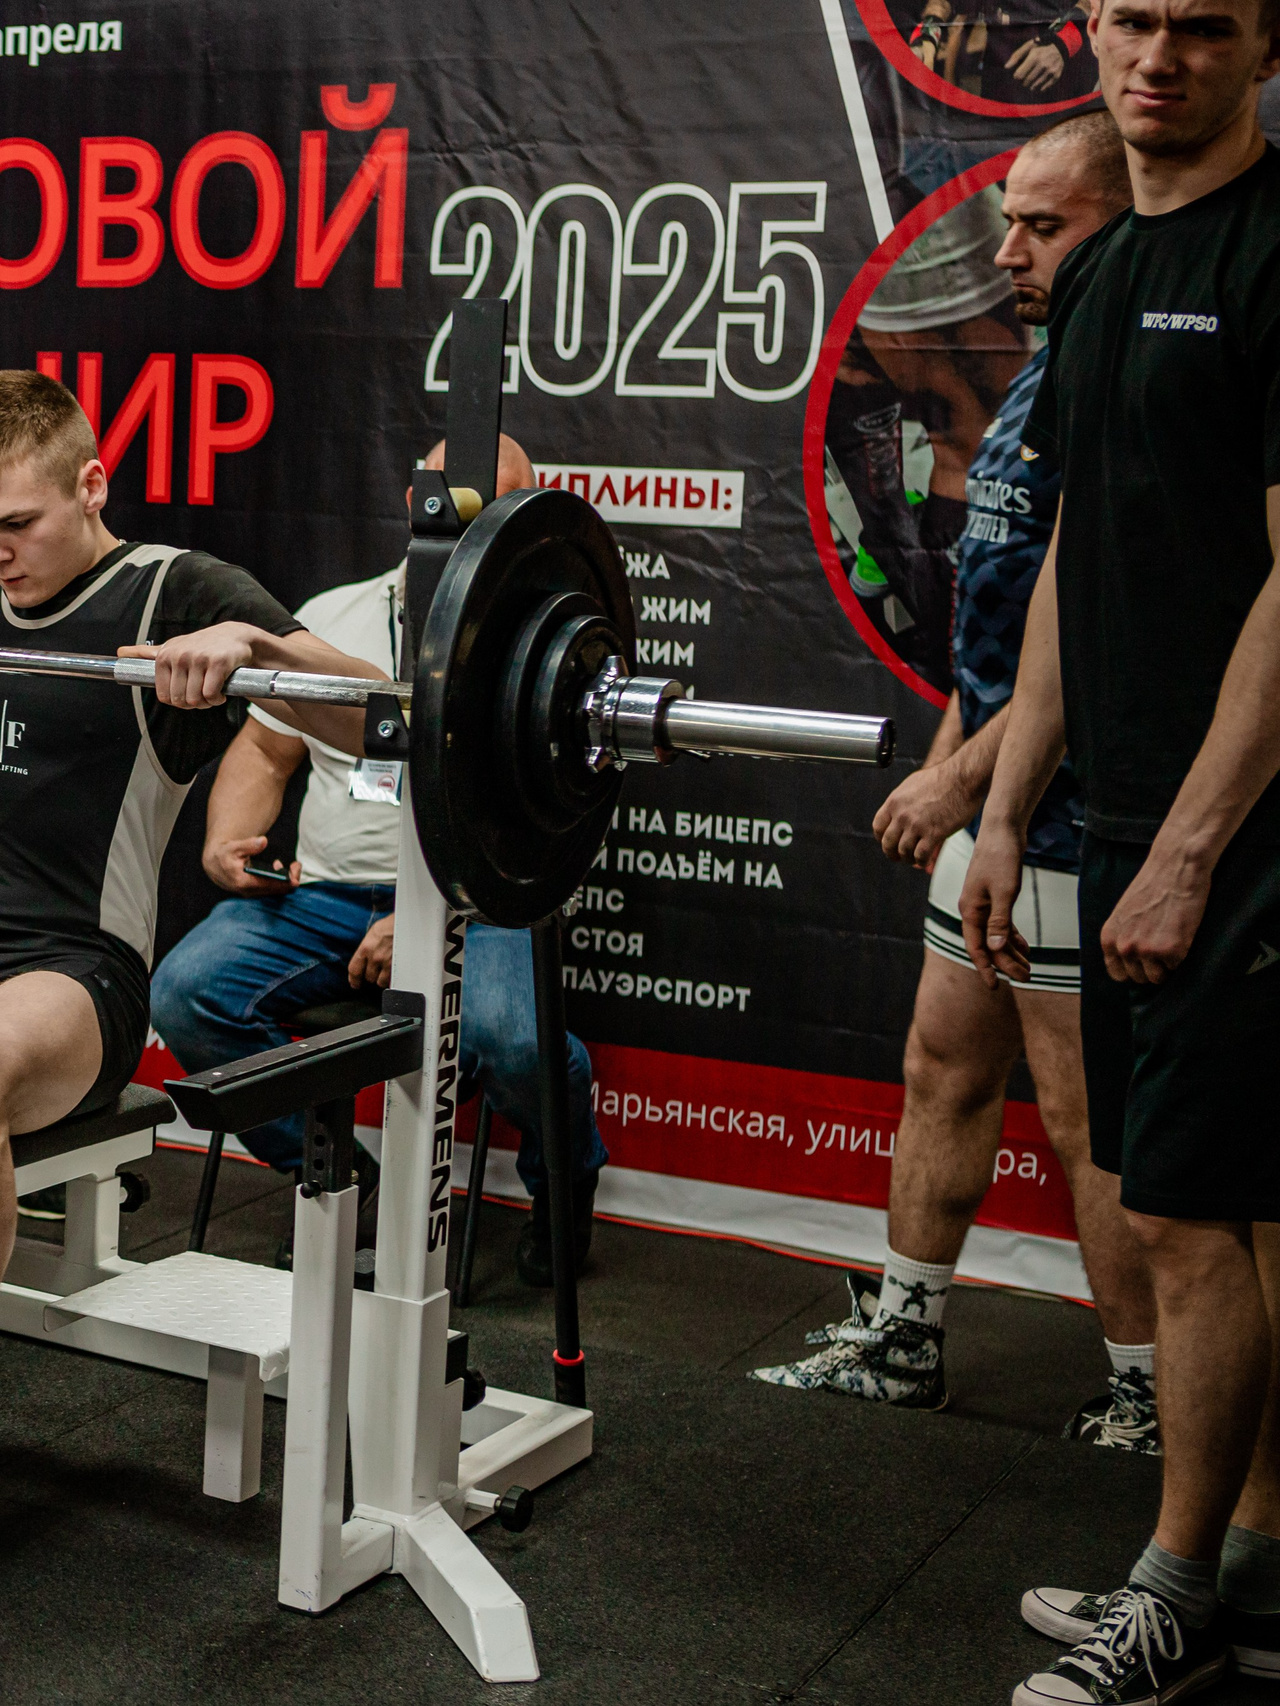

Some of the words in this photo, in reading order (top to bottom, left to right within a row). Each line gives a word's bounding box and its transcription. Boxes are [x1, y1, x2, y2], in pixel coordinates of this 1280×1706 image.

[425, 181, 828, 402] 2025
[1142, 312, 1218, 332] WPC/WPSO
[618, 545, 670, 580] ЖА
[640, 596, 711, 626] ЖИМ
[629, 806, 667, 835] НА
[675, 811, 793, 847] БИЦЕПС
[617, 848, 735, 884] ПОДЪЁМ
[744, 860, 784, 890] НА
[574, 885, 624, 913] ЕПС
[571, 926, 644, 957] СТОЯ
[562, 965, 751, 1012] ПАУЭРСПОРТ
[427, 914, 466, 1253] WERMENS
[804, 1119, 896, 1156] улиц
[992, 1148, 1047, 1187] ра,
